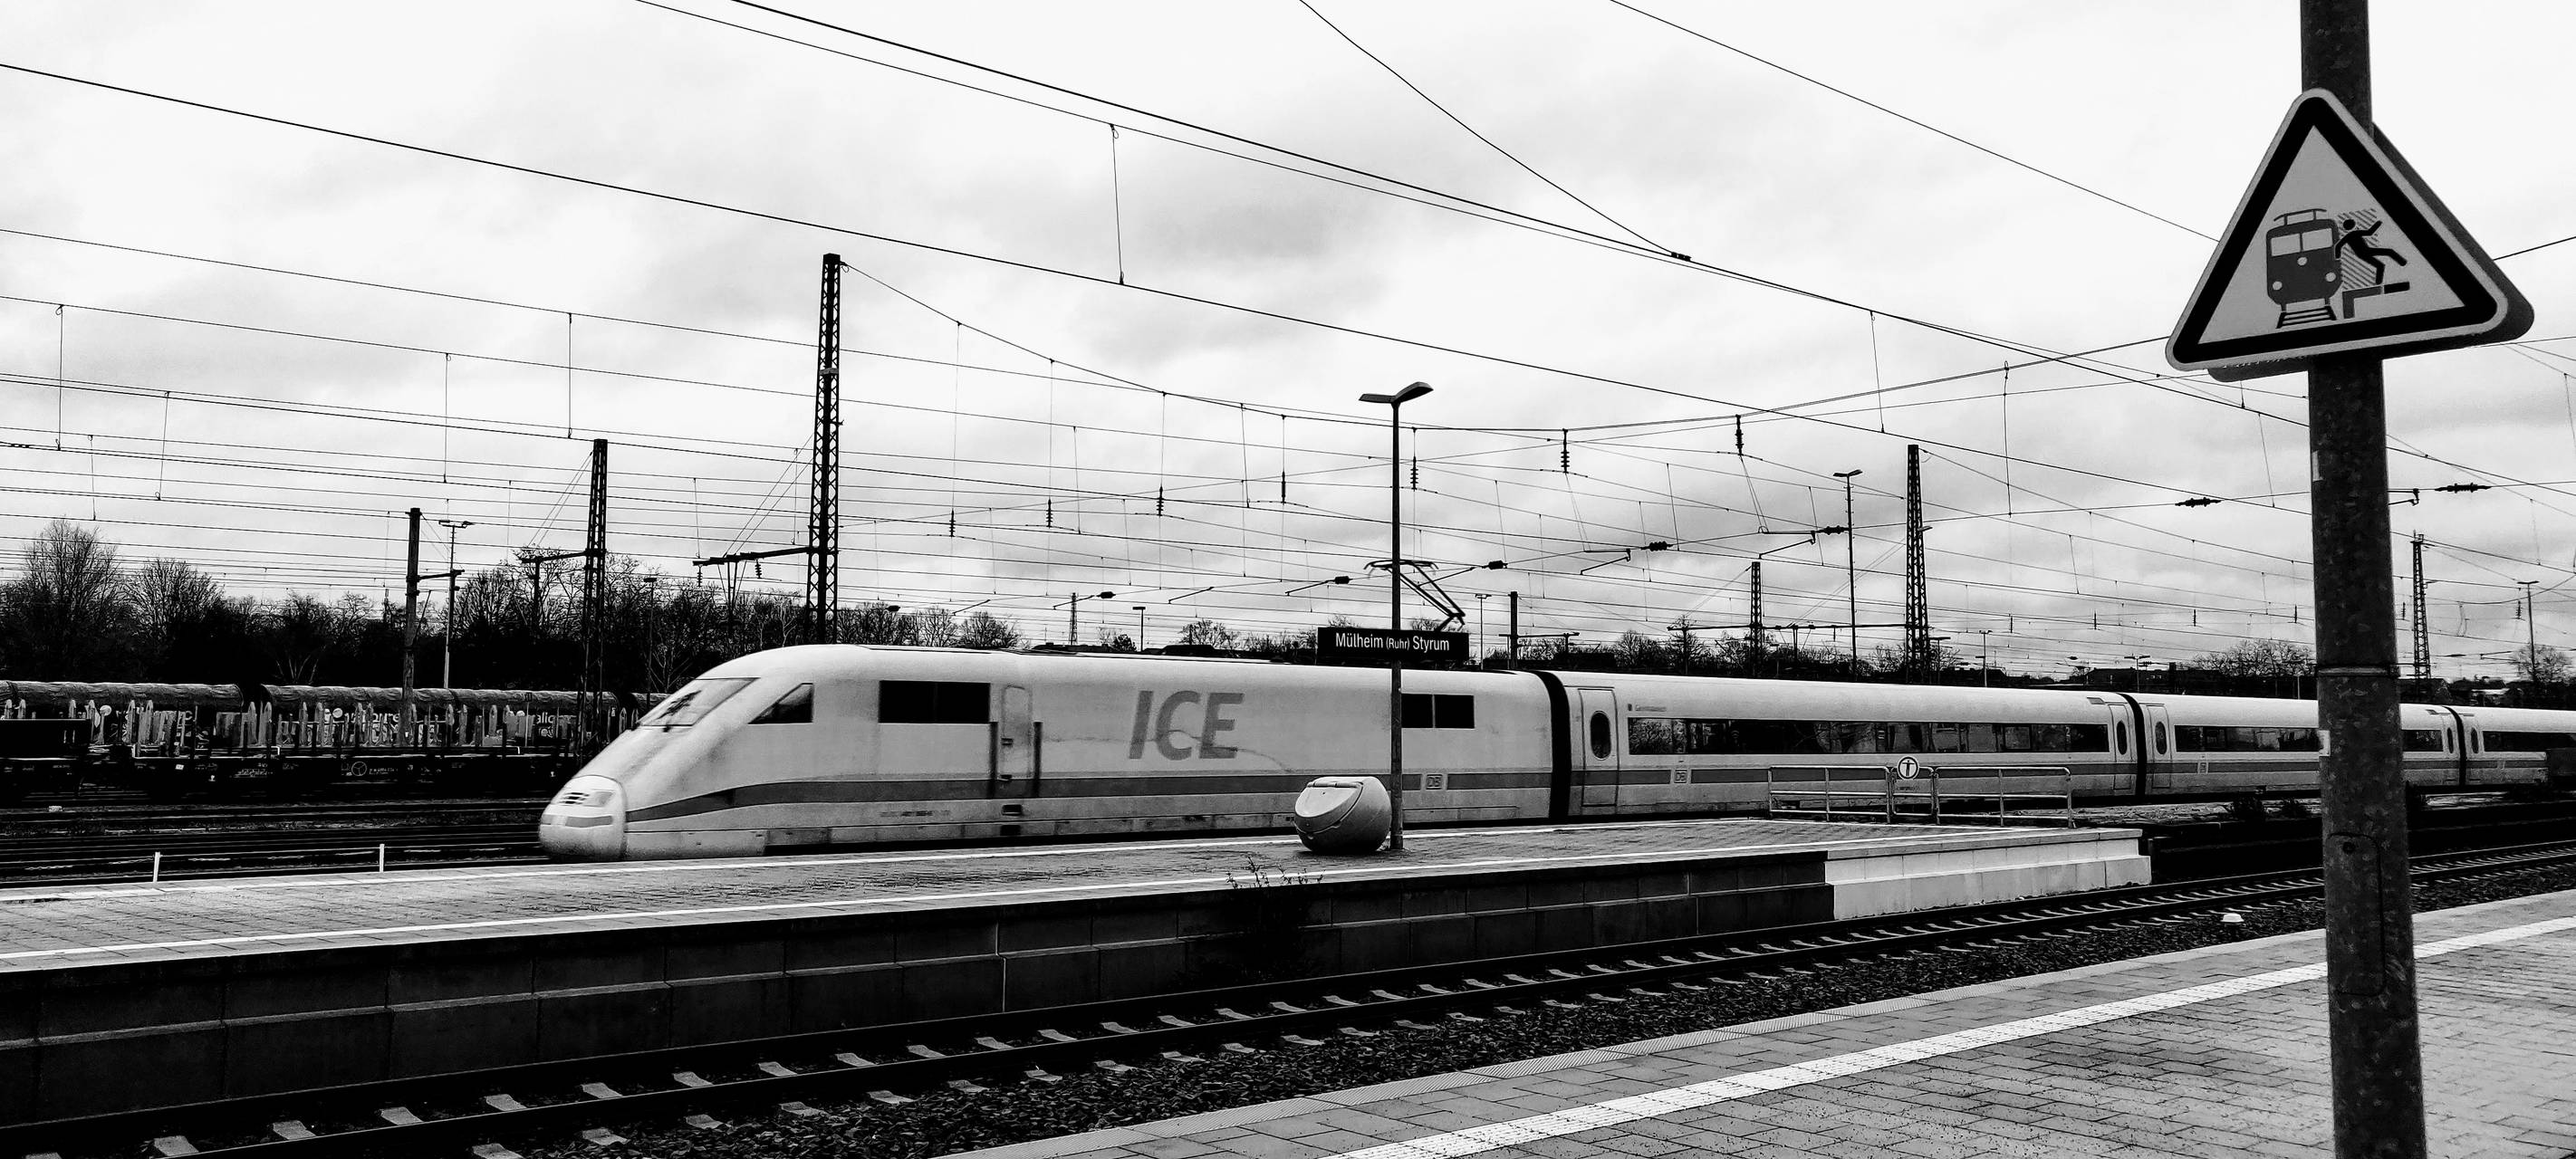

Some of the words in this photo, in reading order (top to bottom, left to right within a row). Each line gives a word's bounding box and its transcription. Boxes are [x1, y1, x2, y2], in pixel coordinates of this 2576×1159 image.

[1335, 632, 1383, 648] Mülheim
[1386, 637, 1410, 651] (Ruhr)
[1412, 635, 1449, 654] Styrum
[1129, 690, 1245, 761] ICE
